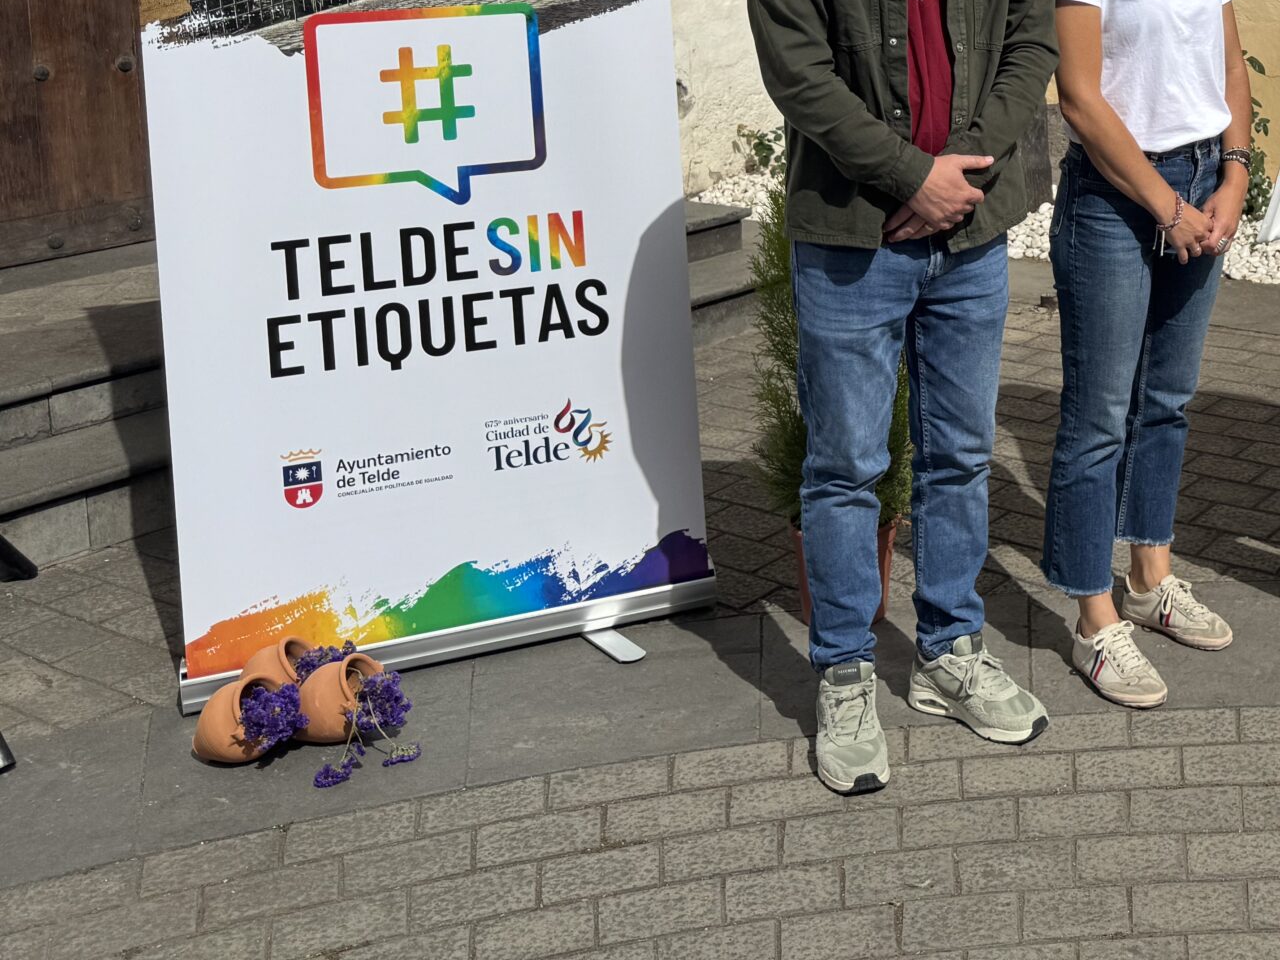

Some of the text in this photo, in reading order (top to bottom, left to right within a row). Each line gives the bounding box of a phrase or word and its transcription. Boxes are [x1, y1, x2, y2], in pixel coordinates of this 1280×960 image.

[267, 279, 609, 378] ETIQUETAS
[503, 413, 549, 426] aniversario
[485, 423, 550, 442] Ciudad de
[336, 444, 452, 474] Ayuntamiento
[487, 436, 570, 471] Telde
[336, 467, 400, 489] de Telde
[337, 485, 374, 498] CONCEJALÍA
[384, 481, 415, 490] POLÍTICAS
[424, 474, 454, 484] IGUALDAD
